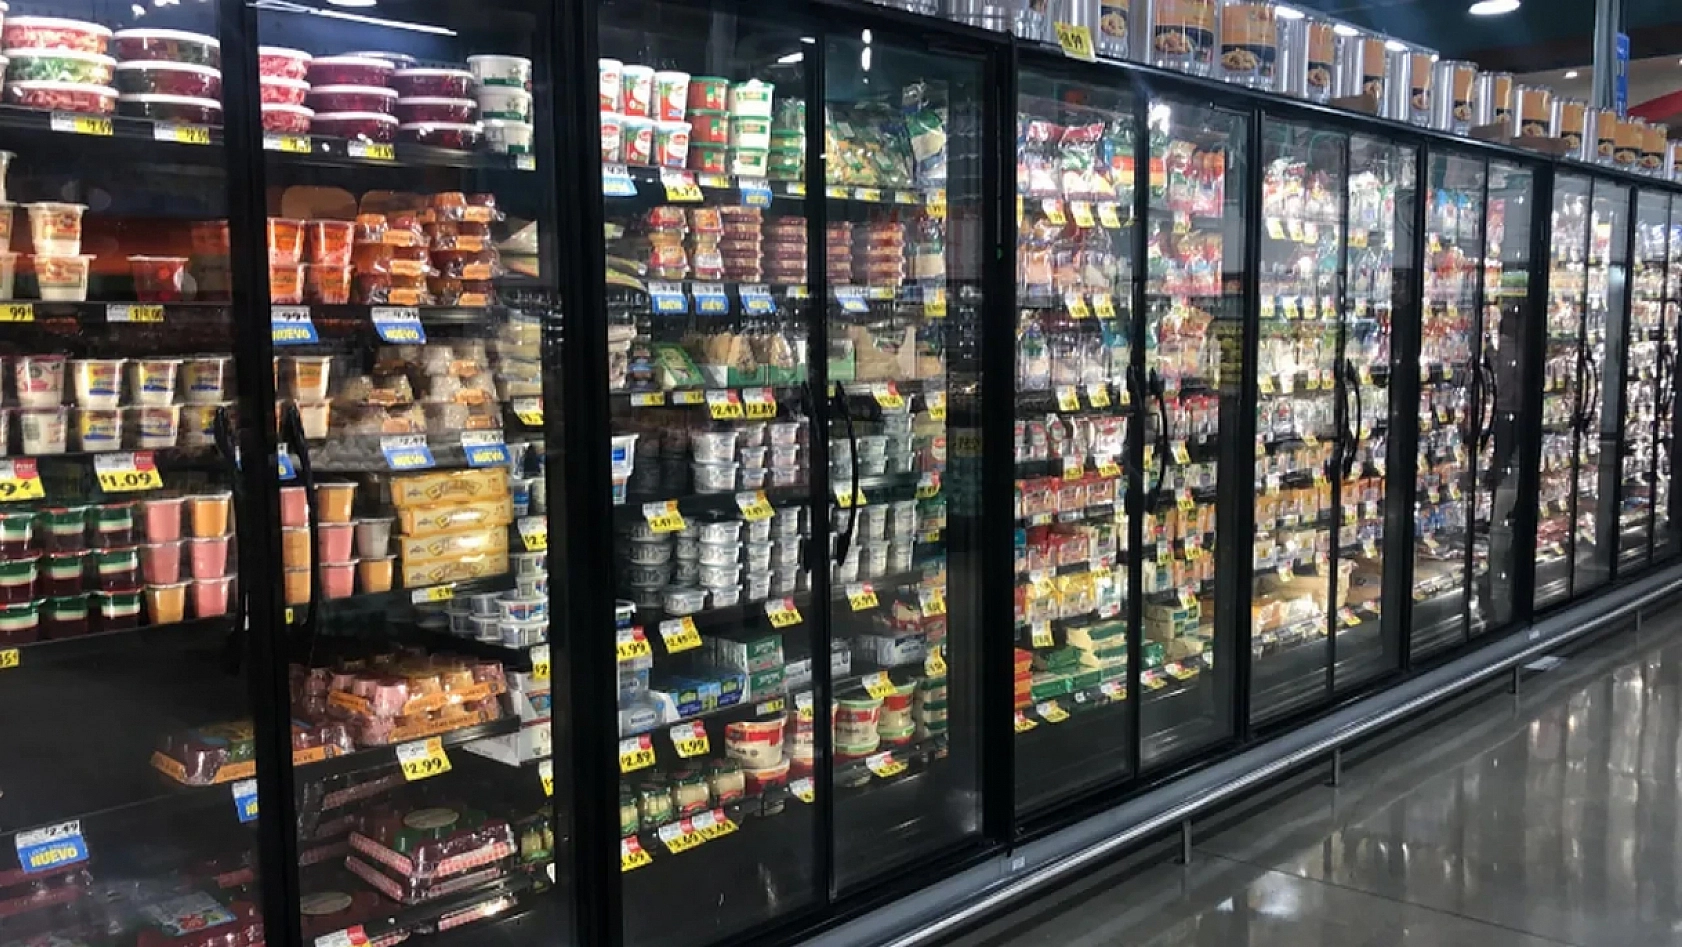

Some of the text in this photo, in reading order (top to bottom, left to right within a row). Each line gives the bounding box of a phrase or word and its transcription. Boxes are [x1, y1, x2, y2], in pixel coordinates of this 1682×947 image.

[100, 472, 152, 488] $1.09
[403, 757, 443, 775] $2.99
[620, 752, 650, 767] $2.89
[30, 848, 77, 866] NUEVO
